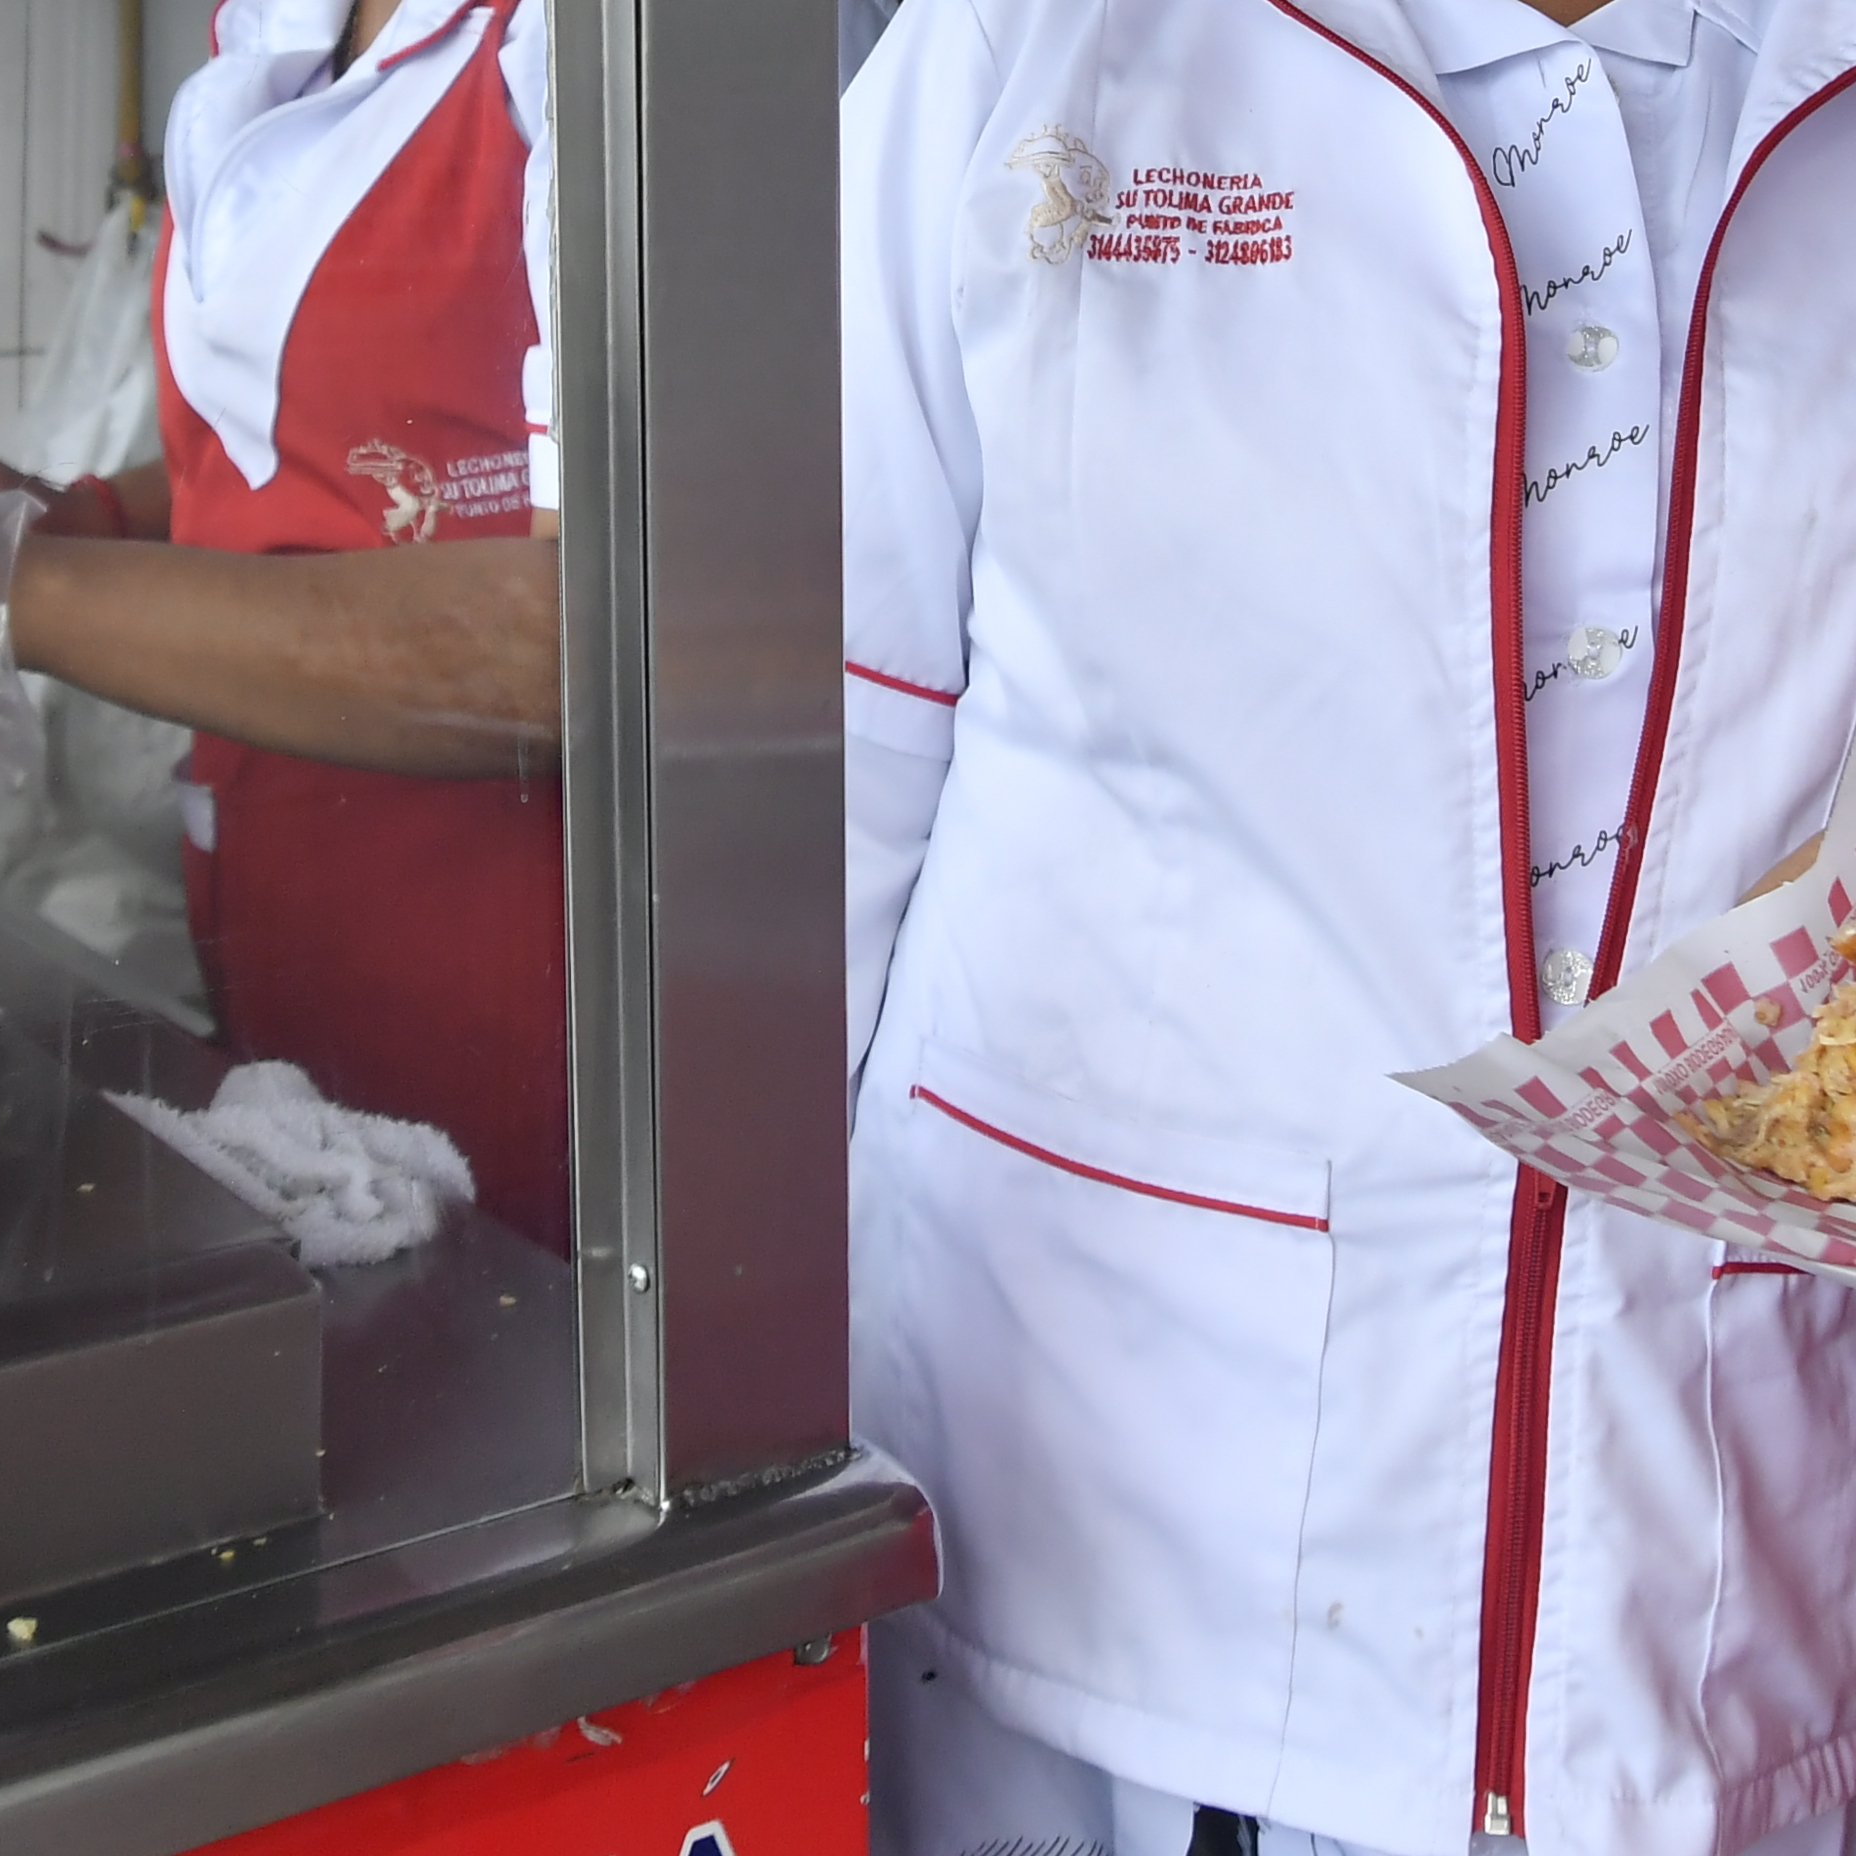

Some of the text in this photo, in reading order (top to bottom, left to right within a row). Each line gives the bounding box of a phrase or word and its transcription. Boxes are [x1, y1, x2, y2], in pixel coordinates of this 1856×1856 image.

[1492, 57, 1591, 188] Monroe
[1132, 167, 1264, 191] LECHONERIA
[1114, 189, 1295, 215] SU TOLIMA GRANDE
[1125, 214, 1182, 231] PUNTO
[1186, 216, 1207, 234] DE
[461, 471, 520, 499] TOLIMA
